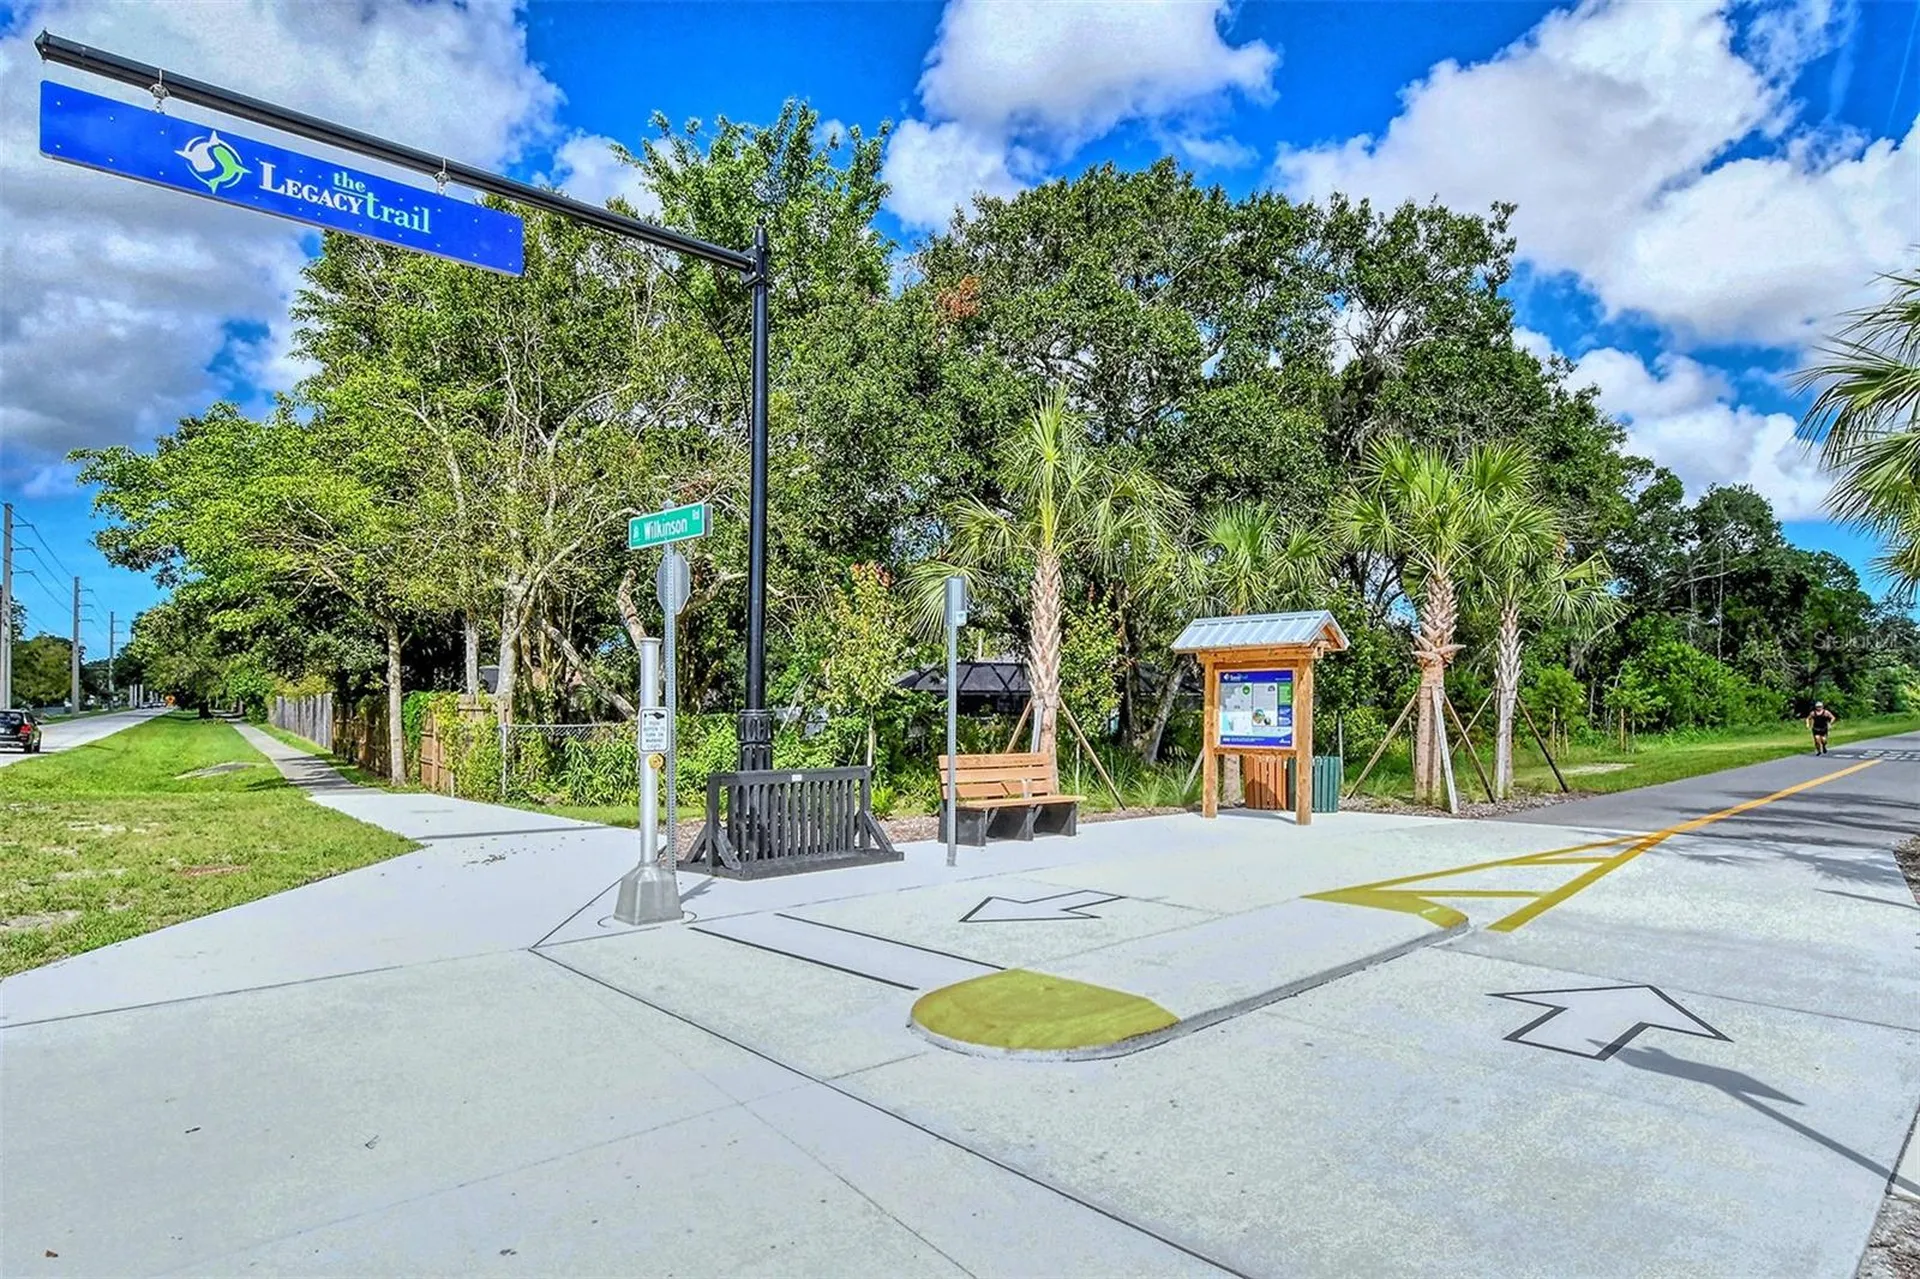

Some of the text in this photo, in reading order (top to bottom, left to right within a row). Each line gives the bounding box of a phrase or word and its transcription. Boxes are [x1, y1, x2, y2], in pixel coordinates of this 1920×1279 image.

[333, 171, 365, 193] the
[259, 161, 432, 233] LEGACY trail
[644, 518, 688, 540] Wilkinson
